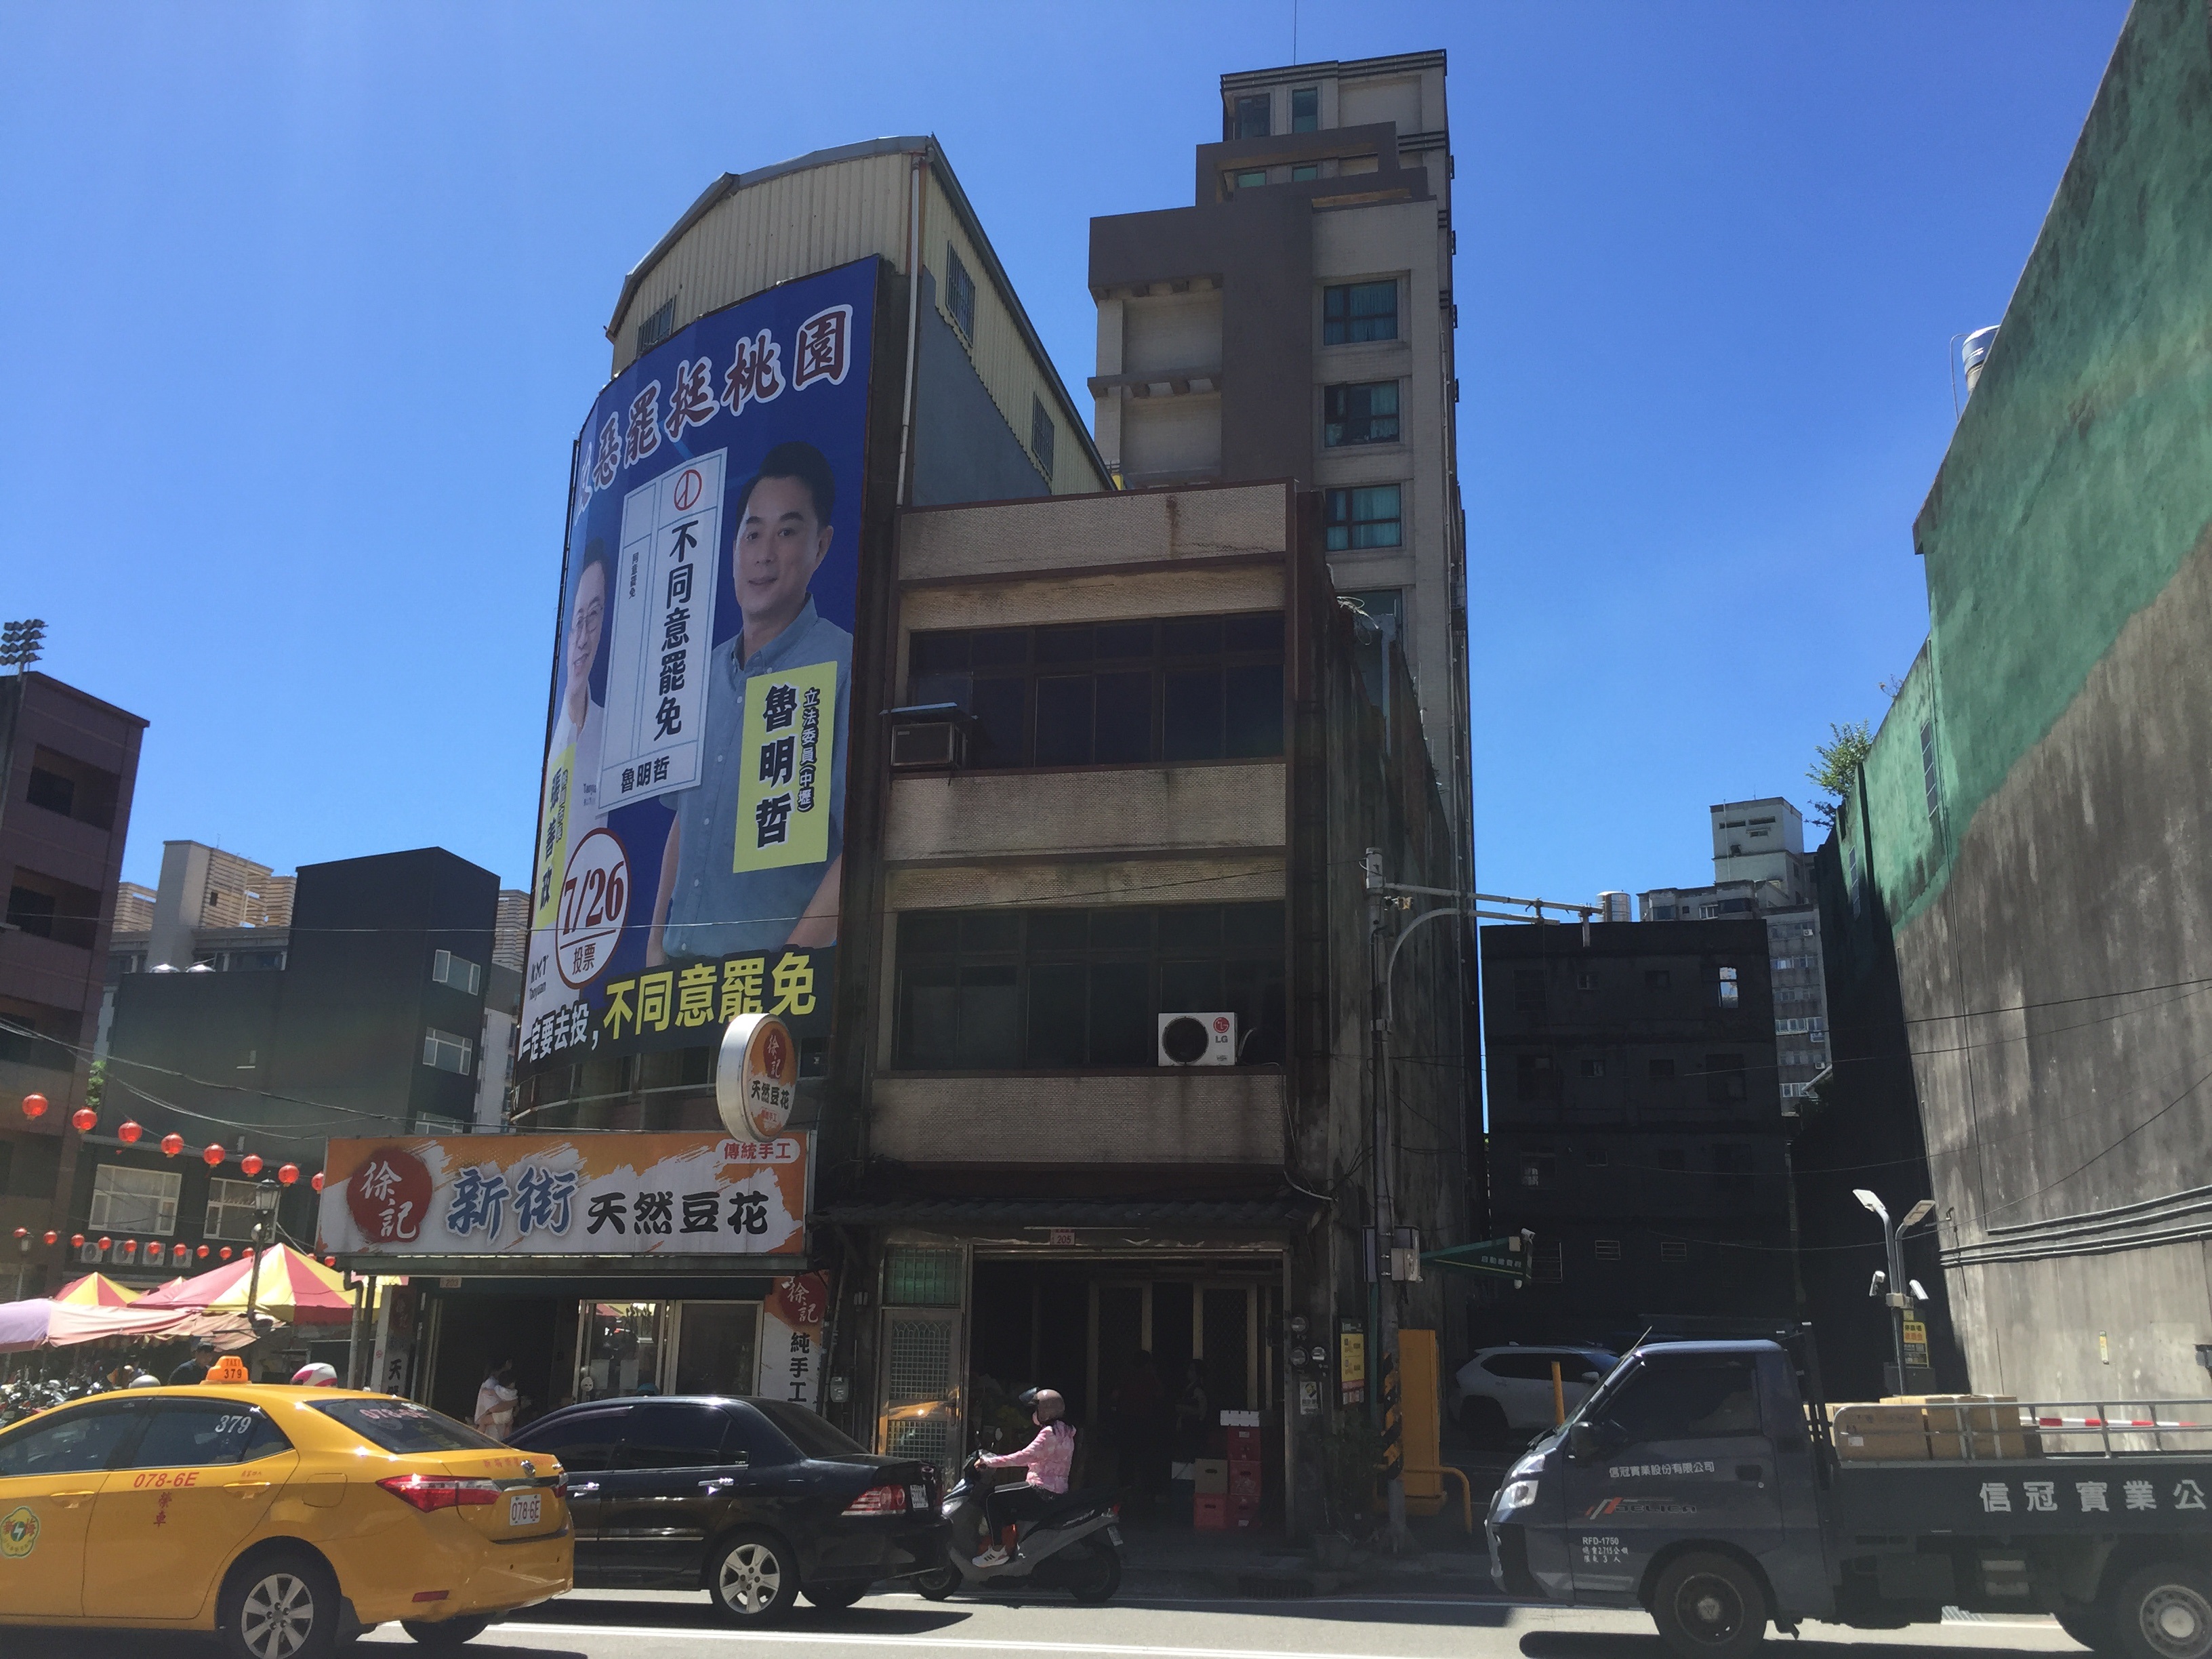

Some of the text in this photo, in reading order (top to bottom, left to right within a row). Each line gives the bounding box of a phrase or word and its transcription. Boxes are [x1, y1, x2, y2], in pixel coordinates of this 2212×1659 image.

[654, 520, 699, 741] 不同意罷免
[621, 756, 670, 794] 魯明哲
[756, 683, 798, 851] 魯明哲
[564, 861, 624, 935] 7/26
[531, 955, 549, 983] KMT
[573, 943, 596, 975] 投票
[767, 1035, 781, 1078] 徐記
[751, 1080, 789, 1110] 天然豆花
[724, 1141, 792, 1160] 傳統手工
[359, 1160, 417, 1240] 徐記
[447, 1165, 578, 1244] 新街
[587, 1190, 769, 1235] 天然豆花
[1057, 1235, 1071, 1244] 205
[787, 1282, 819, 1322] 徐記
[224, 1369, 242, 1378] 379
[787, 1332, 811, 1402] 純手工
[215, 1415, 251, 1433] 379
[134, 1471, 199, 1488] 078-6E
[1610, 1461, 1715, 1477] 信冠實業股份有限公司
[511, 1500, 540, 1521] 078-6E
[1980, 1479, 2207, 1512] 信冠實業公
[1582, 1537, 1619, 1545] RFD-1750
